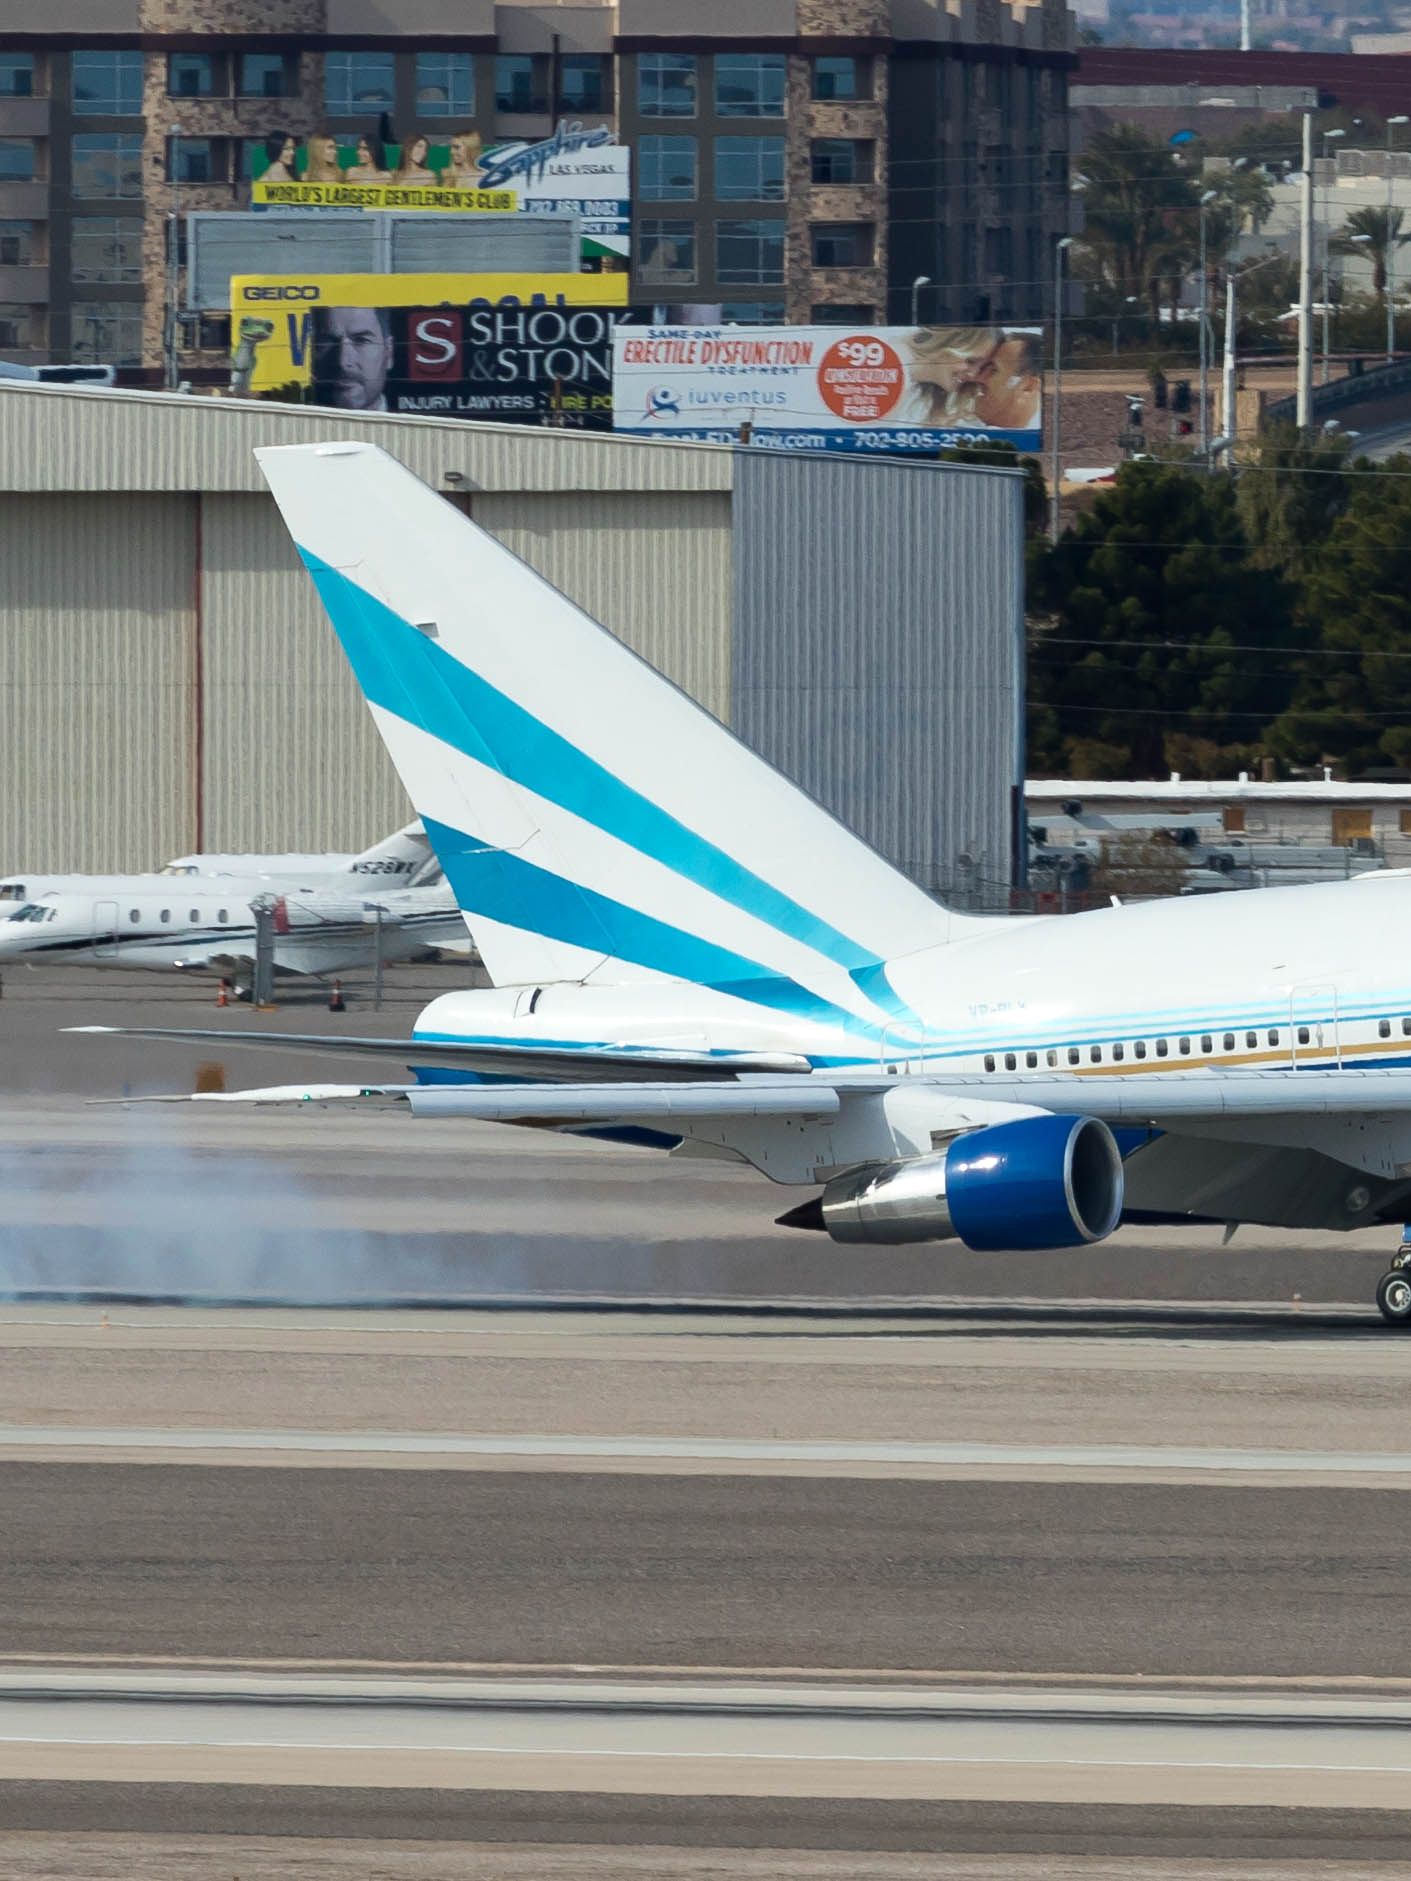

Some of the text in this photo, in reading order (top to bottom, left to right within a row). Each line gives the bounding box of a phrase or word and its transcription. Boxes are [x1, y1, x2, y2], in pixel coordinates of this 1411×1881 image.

[476, 119, 618, 190] Sapphire
[549, 164, 615, 175] LAS VEGAS
[265, 185, 511, 209] WORLD'S LARGEST GENTLEMEN'S CLUB
[243, 286, 320, 300] GEICO
[414, 317, 457, 364] S
[624, 341, 814, 365] ERECTILE DYSFUNCTION
[837, 342, 885, 368] $99
[708, 366, 800, 376] TREATMENT
[398, 396, 450, 410] INJURY
[457, 396, 535, 410] LAWYERS
